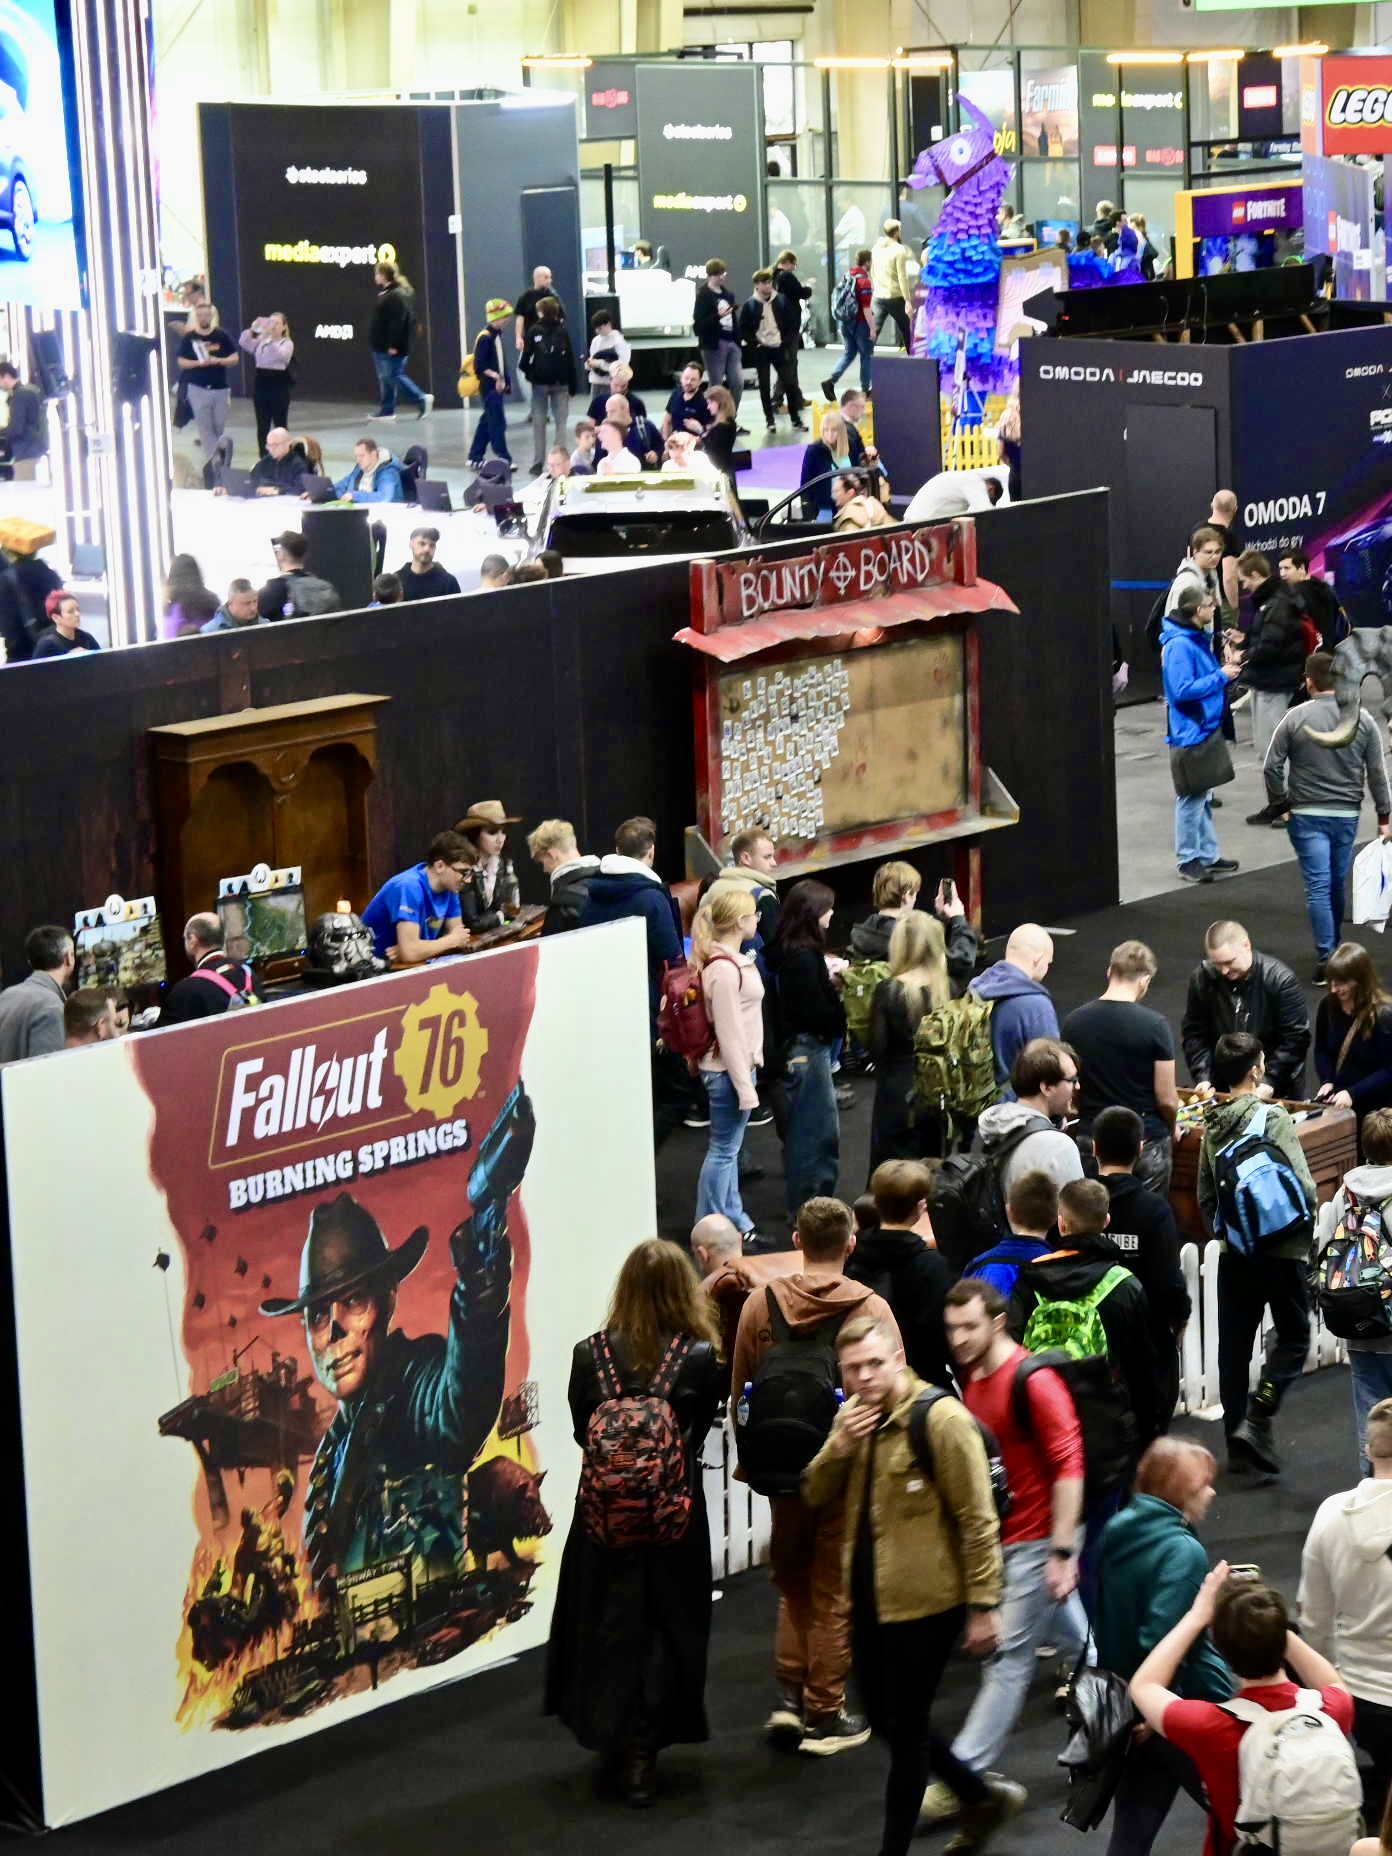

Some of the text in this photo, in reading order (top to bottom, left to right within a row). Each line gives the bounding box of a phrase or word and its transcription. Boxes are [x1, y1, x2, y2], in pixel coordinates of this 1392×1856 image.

[1247, 198, 1286, 222] FORTNITE
[264, 240, 378, 268] mediaexpert
[1244, 490, 1327, 528] OMODA 7
[1279, 535, 1290, 548] do
[740, 539, 930, 617] BOUNTY BOARD
[226, 1008, 467, 1147] Fallout 76
[229, 1119, 468, 1210] BURNING SPRINGS
